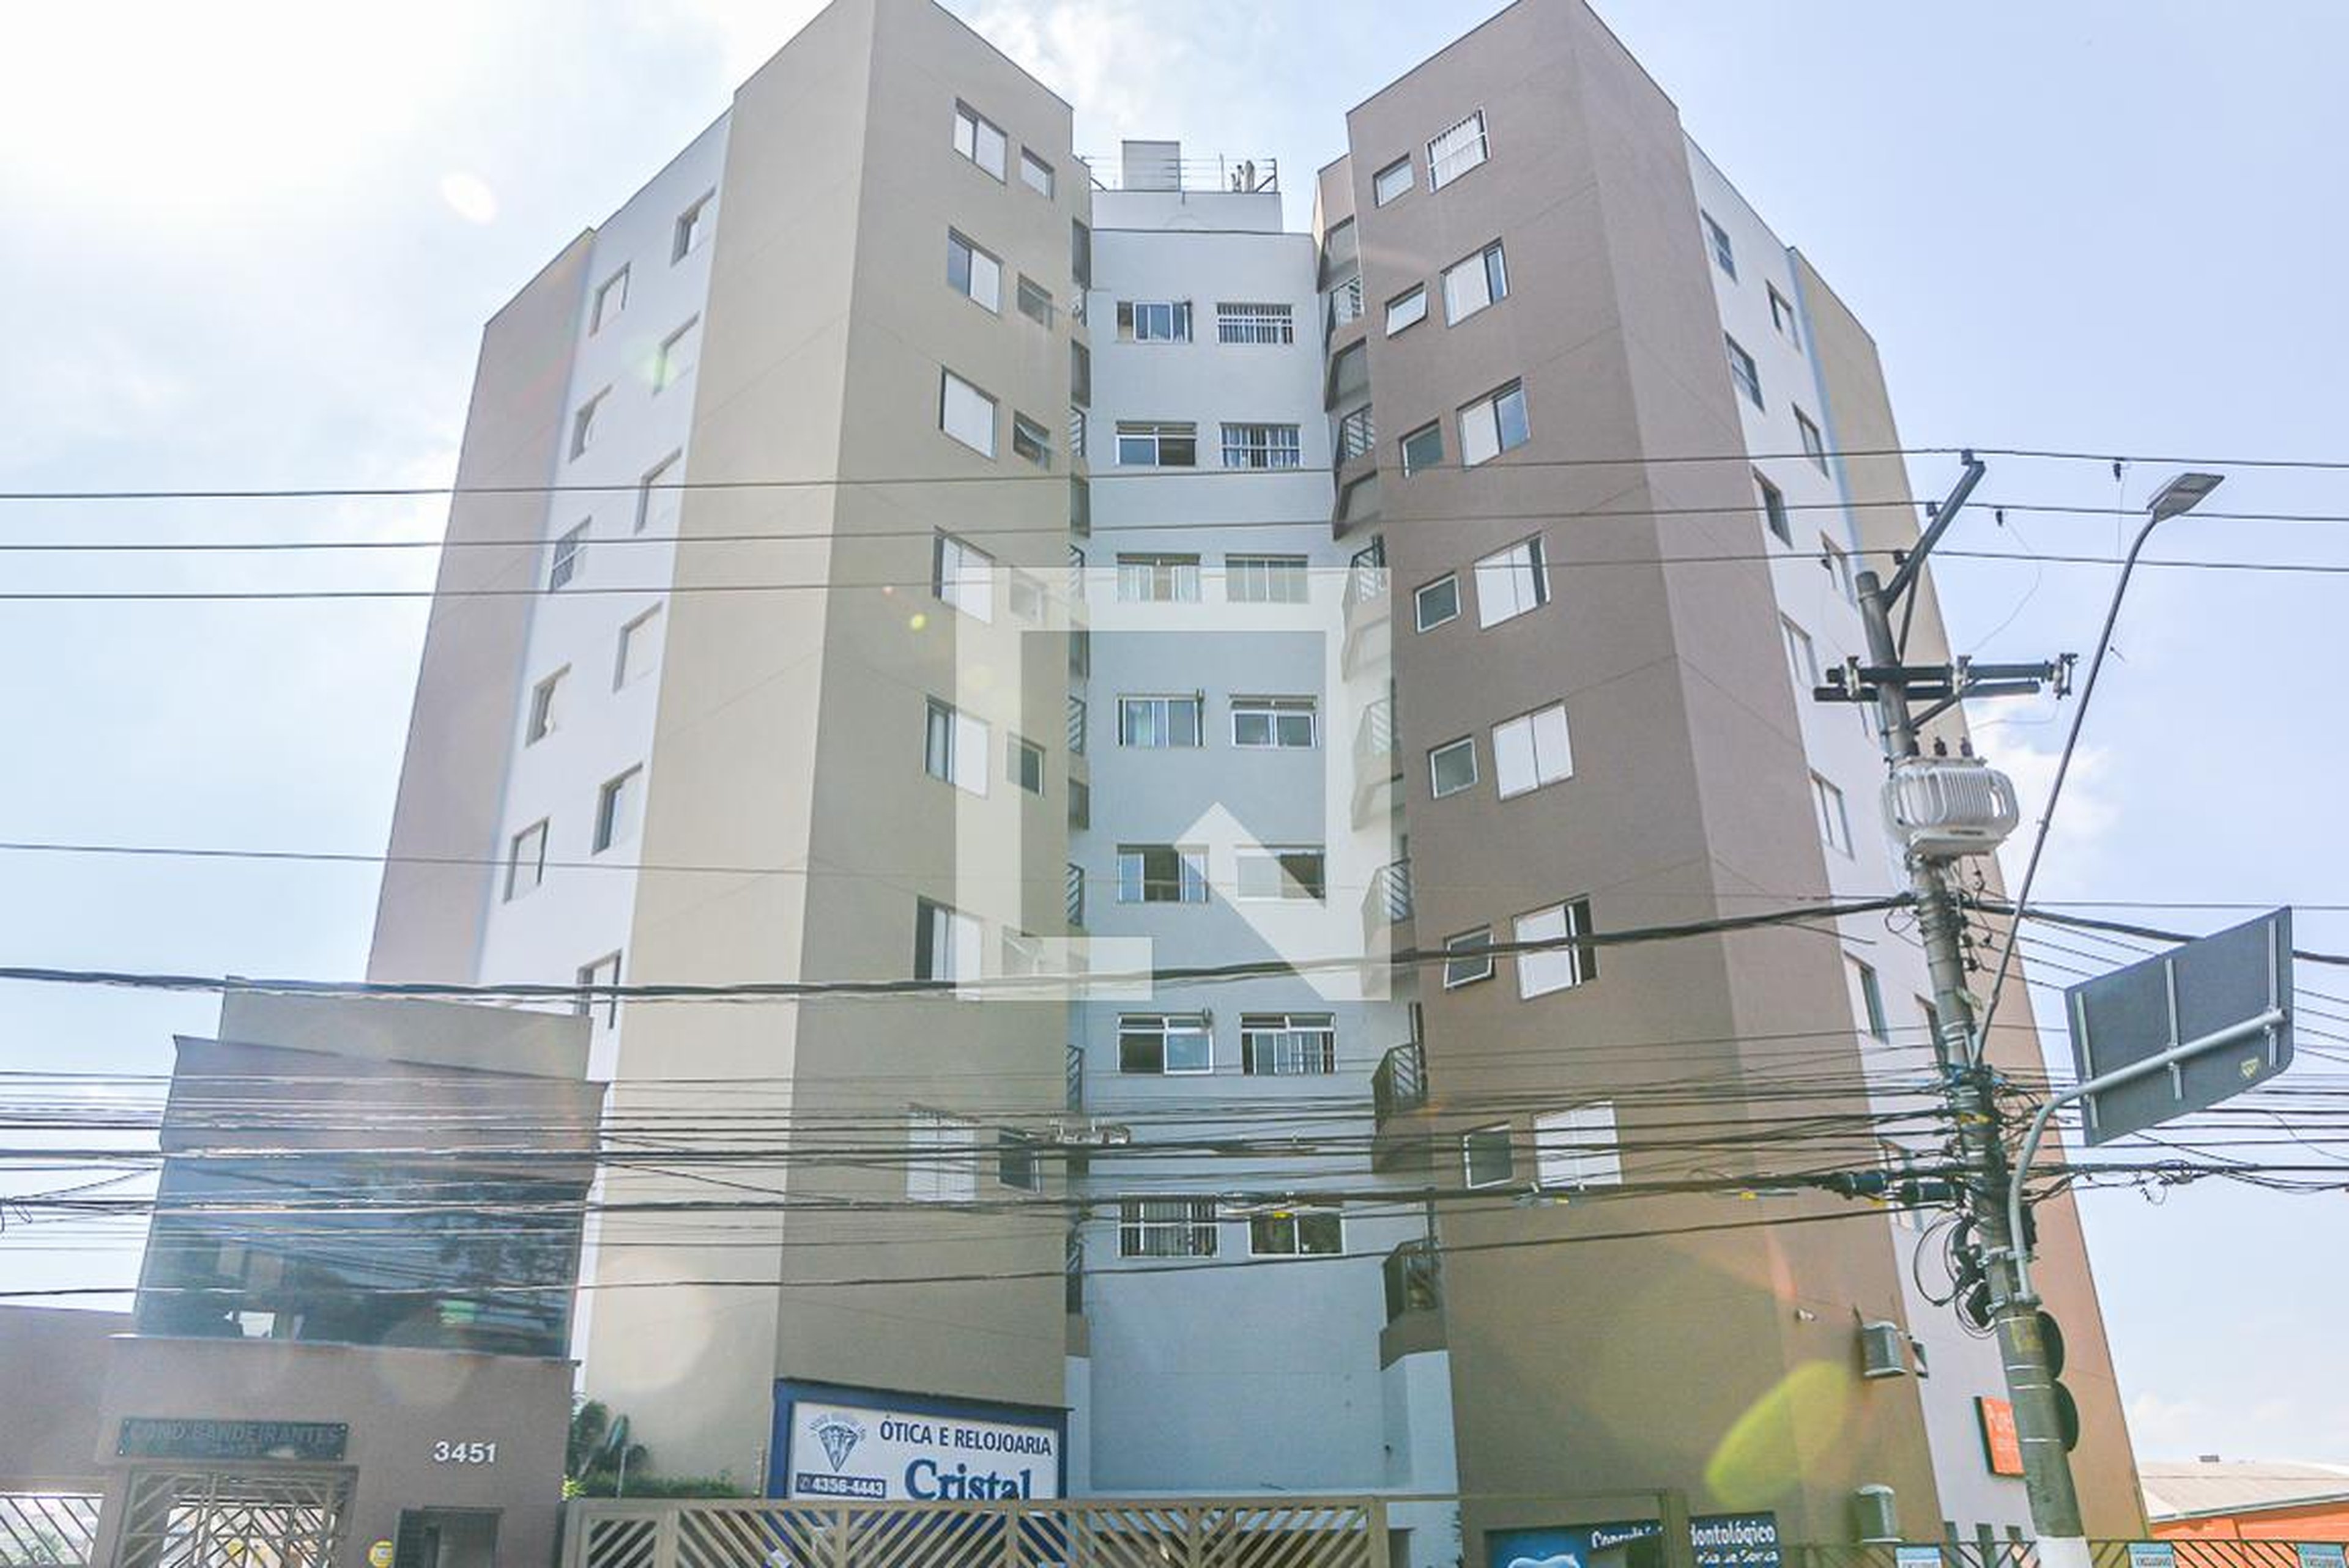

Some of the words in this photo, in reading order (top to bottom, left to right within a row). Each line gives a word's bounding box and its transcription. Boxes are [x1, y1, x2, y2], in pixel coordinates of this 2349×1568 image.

[434, 1441, 496, 1463] 3451
[880, 1415, 933, 1444] ÓTICA
[939, 1427, 949, 1446] E
[954, 1429, 1052, 1455] RELOJOARIA
[905, 1459, 1031, 1500] Cristal
